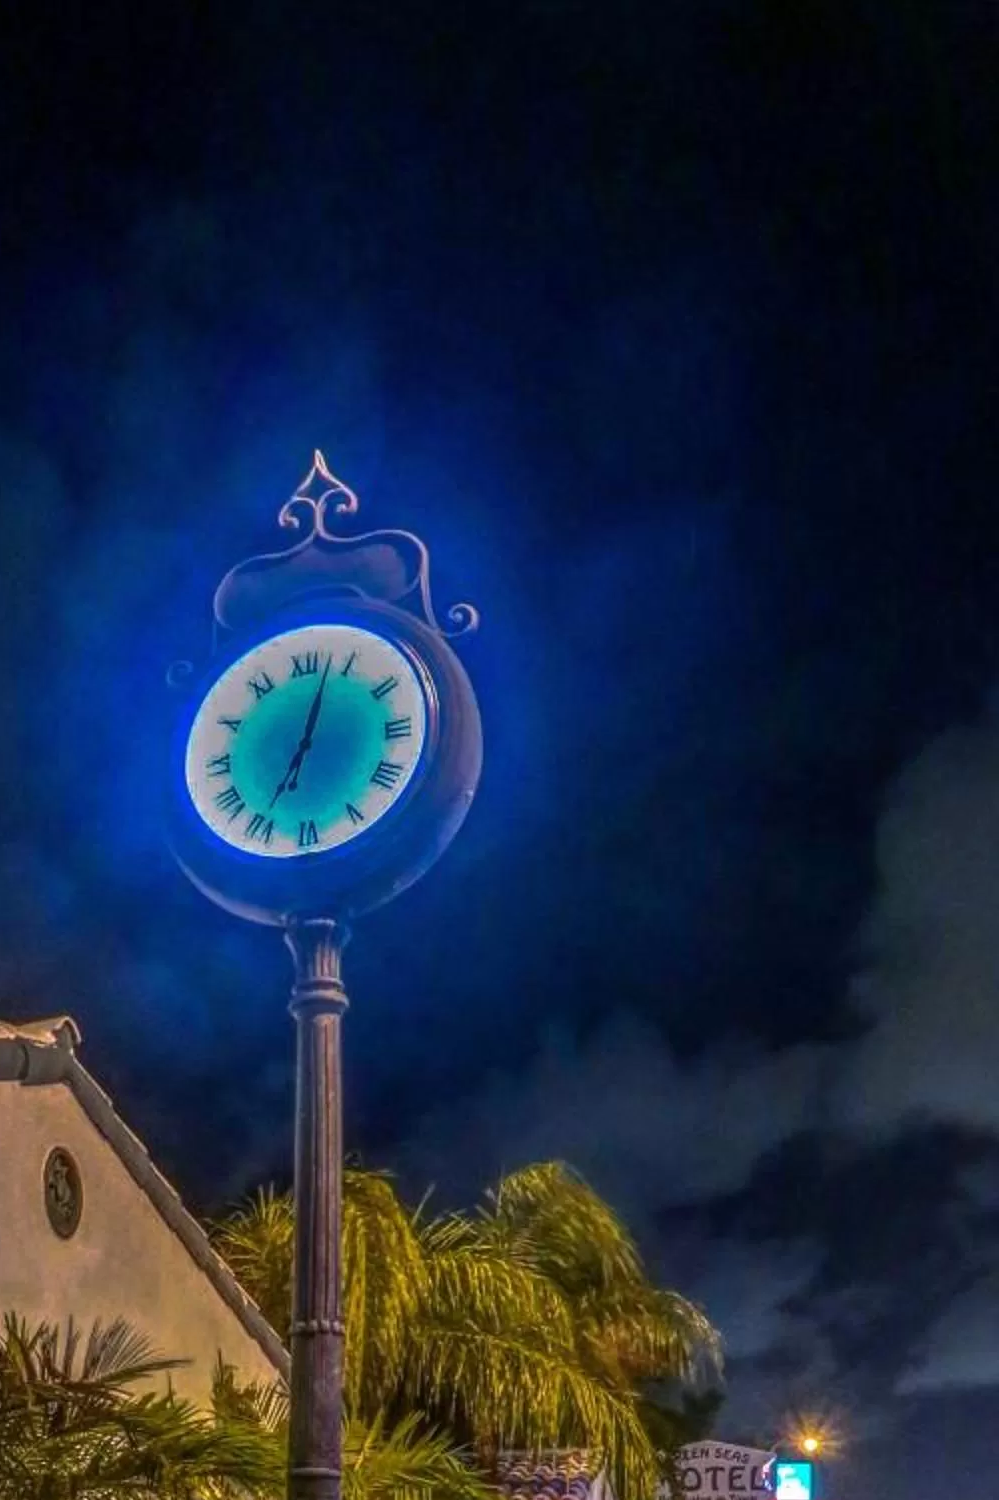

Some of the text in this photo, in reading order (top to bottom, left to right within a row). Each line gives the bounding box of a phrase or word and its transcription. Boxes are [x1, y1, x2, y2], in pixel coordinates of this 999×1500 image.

[291, 651, 318, 678] XII
[371, 676, 398, 701] II
[384, 716, 412, 740] III
[345, 802, 364, 825] V
[298, 819, 319, 847] VI
[714, 1449, 750, 1463] SEAS
[661, 1465, 767, 1492] OTEL
